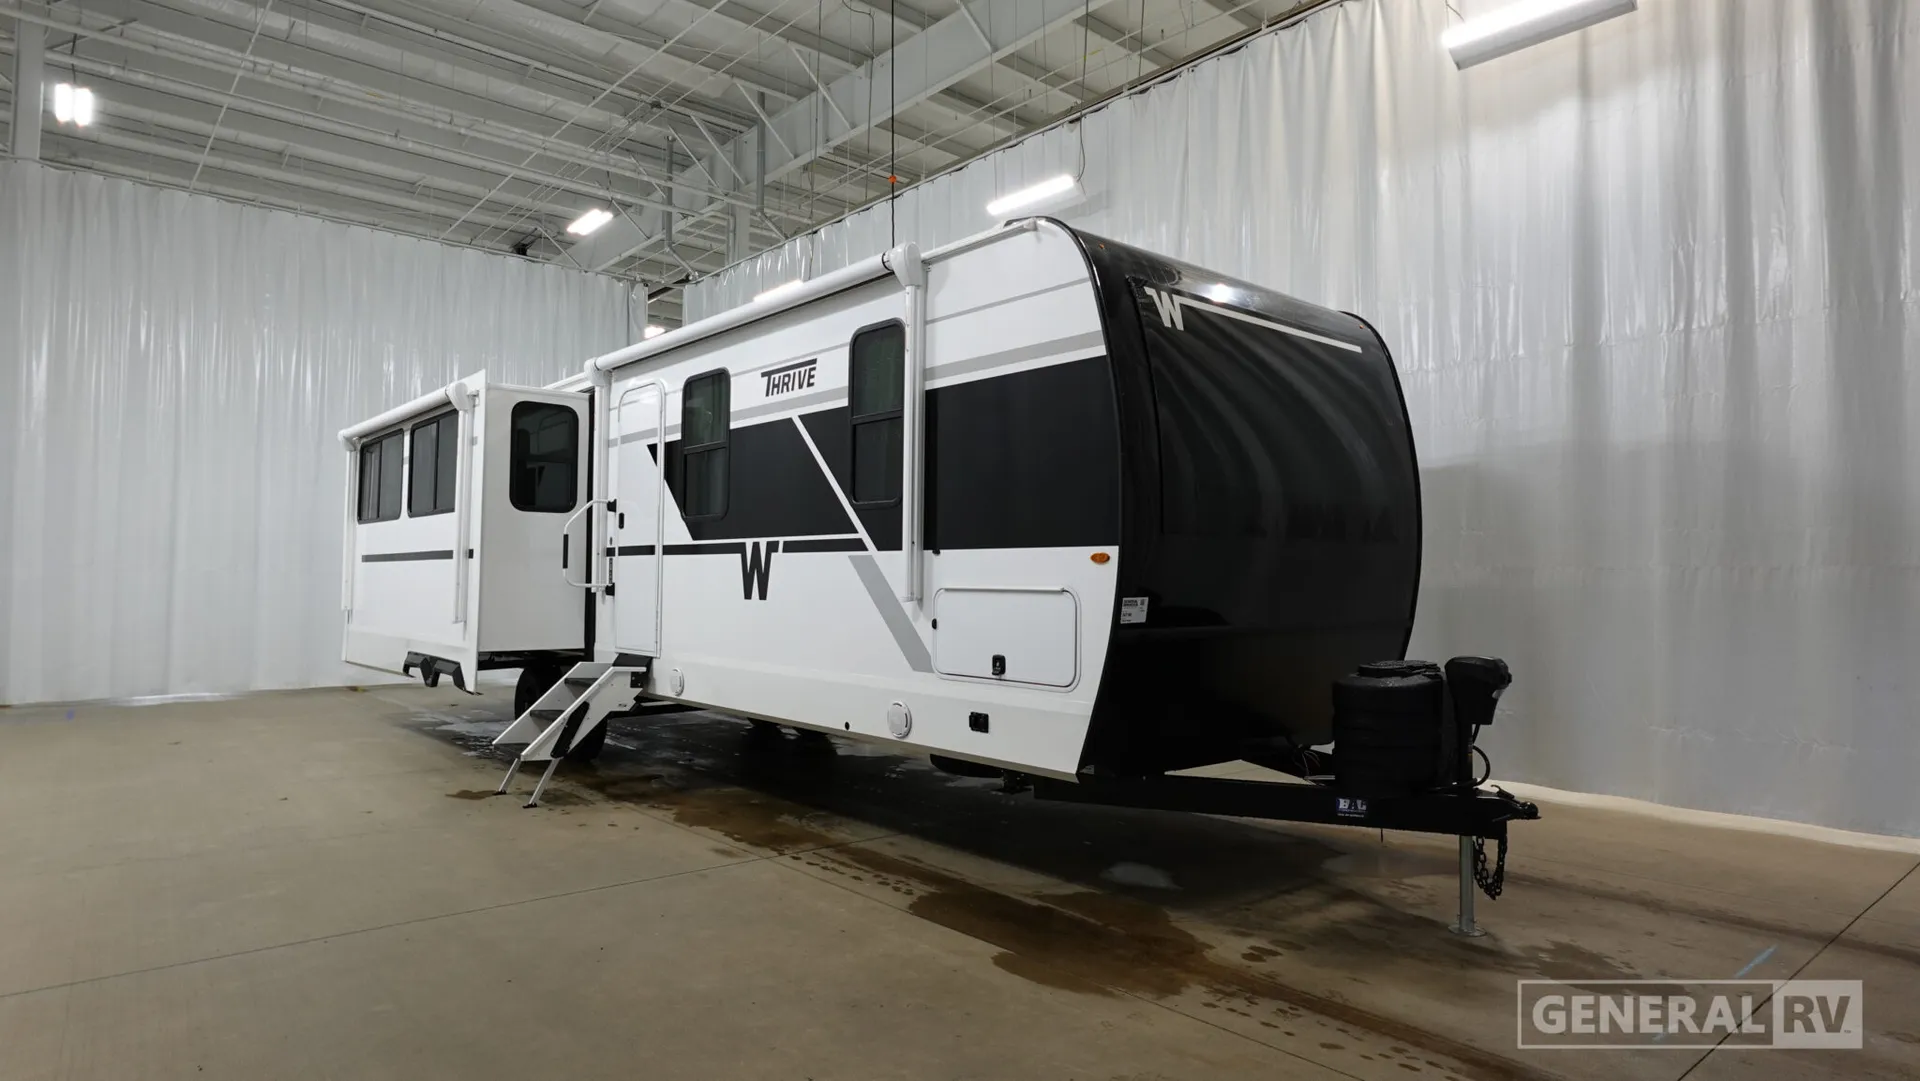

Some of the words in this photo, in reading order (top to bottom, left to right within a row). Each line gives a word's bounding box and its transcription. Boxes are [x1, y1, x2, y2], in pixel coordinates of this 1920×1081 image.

[1143, 286, 1184, 331] W
[760, 358, 818, 398] THRIVE
[740, 540, 779, 601] W
